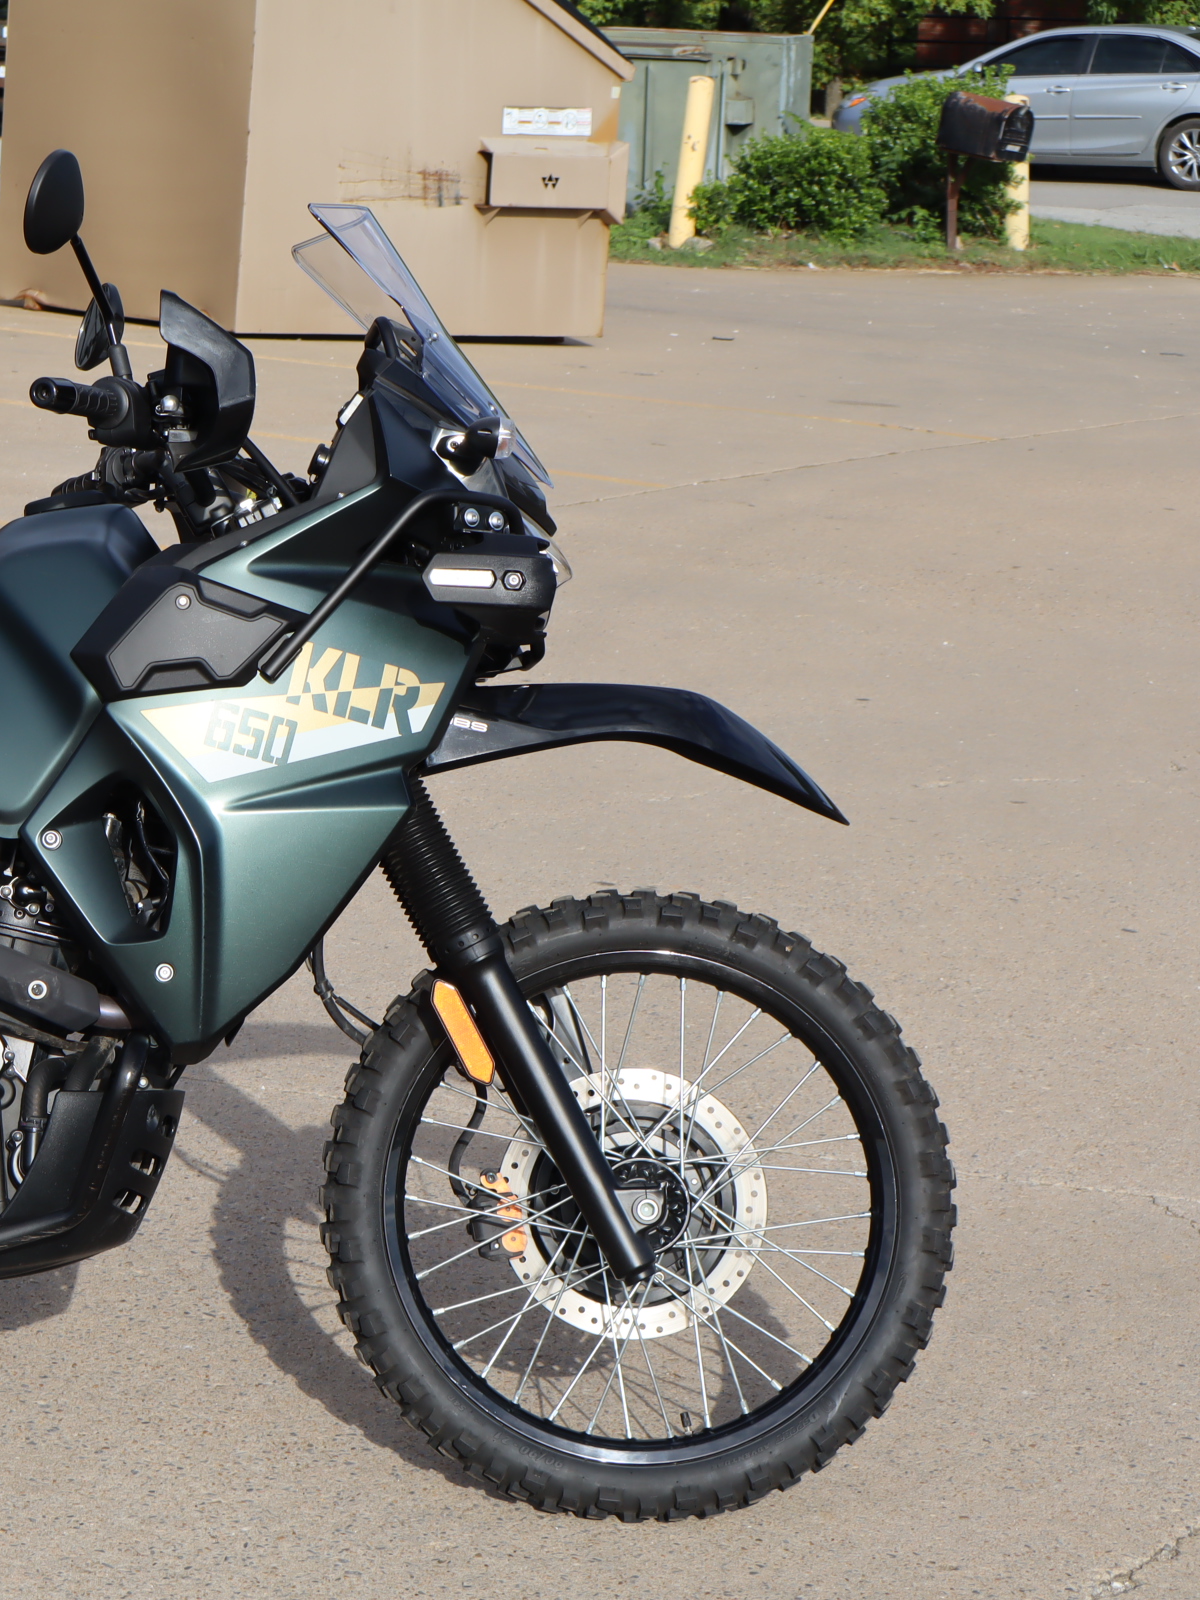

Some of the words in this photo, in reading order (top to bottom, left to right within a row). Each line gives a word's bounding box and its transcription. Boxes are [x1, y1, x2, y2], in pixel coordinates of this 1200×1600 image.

[286, 641, 423, 736] KLR
[203, 700, 298, 765] 650
[449, 717, 489, 733] BS
